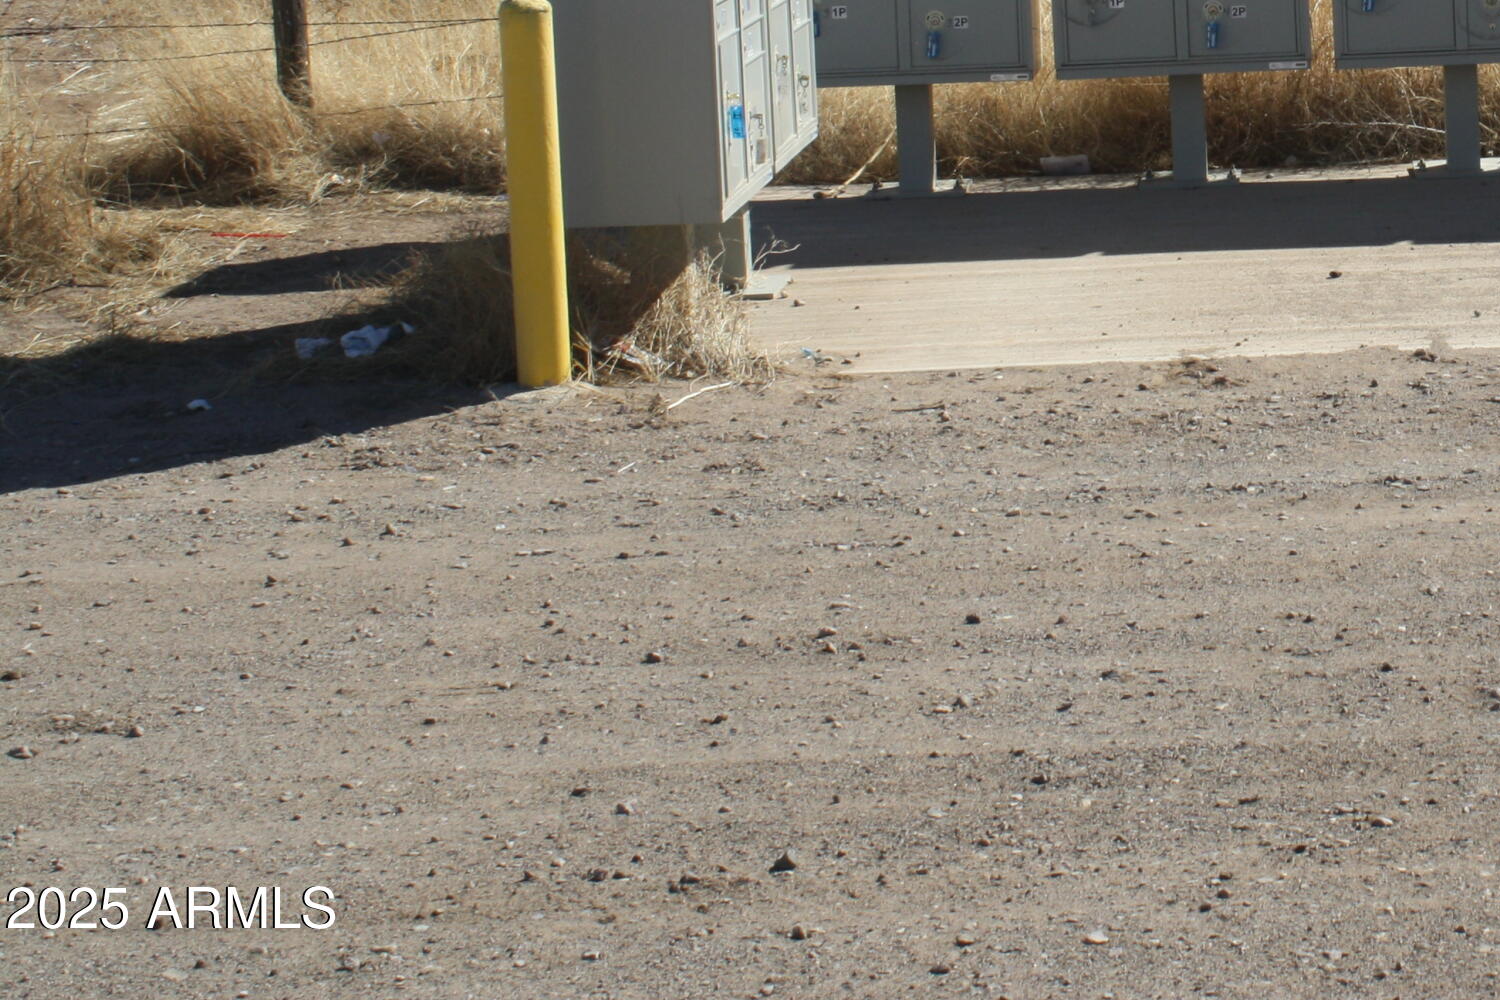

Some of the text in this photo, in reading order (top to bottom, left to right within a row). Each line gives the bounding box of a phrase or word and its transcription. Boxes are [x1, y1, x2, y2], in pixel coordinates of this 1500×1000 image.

[832, 7, 847, 17] 1P
[1232, 6, 1246, 17] 2P
[954, 17, 968, 28] 2P
